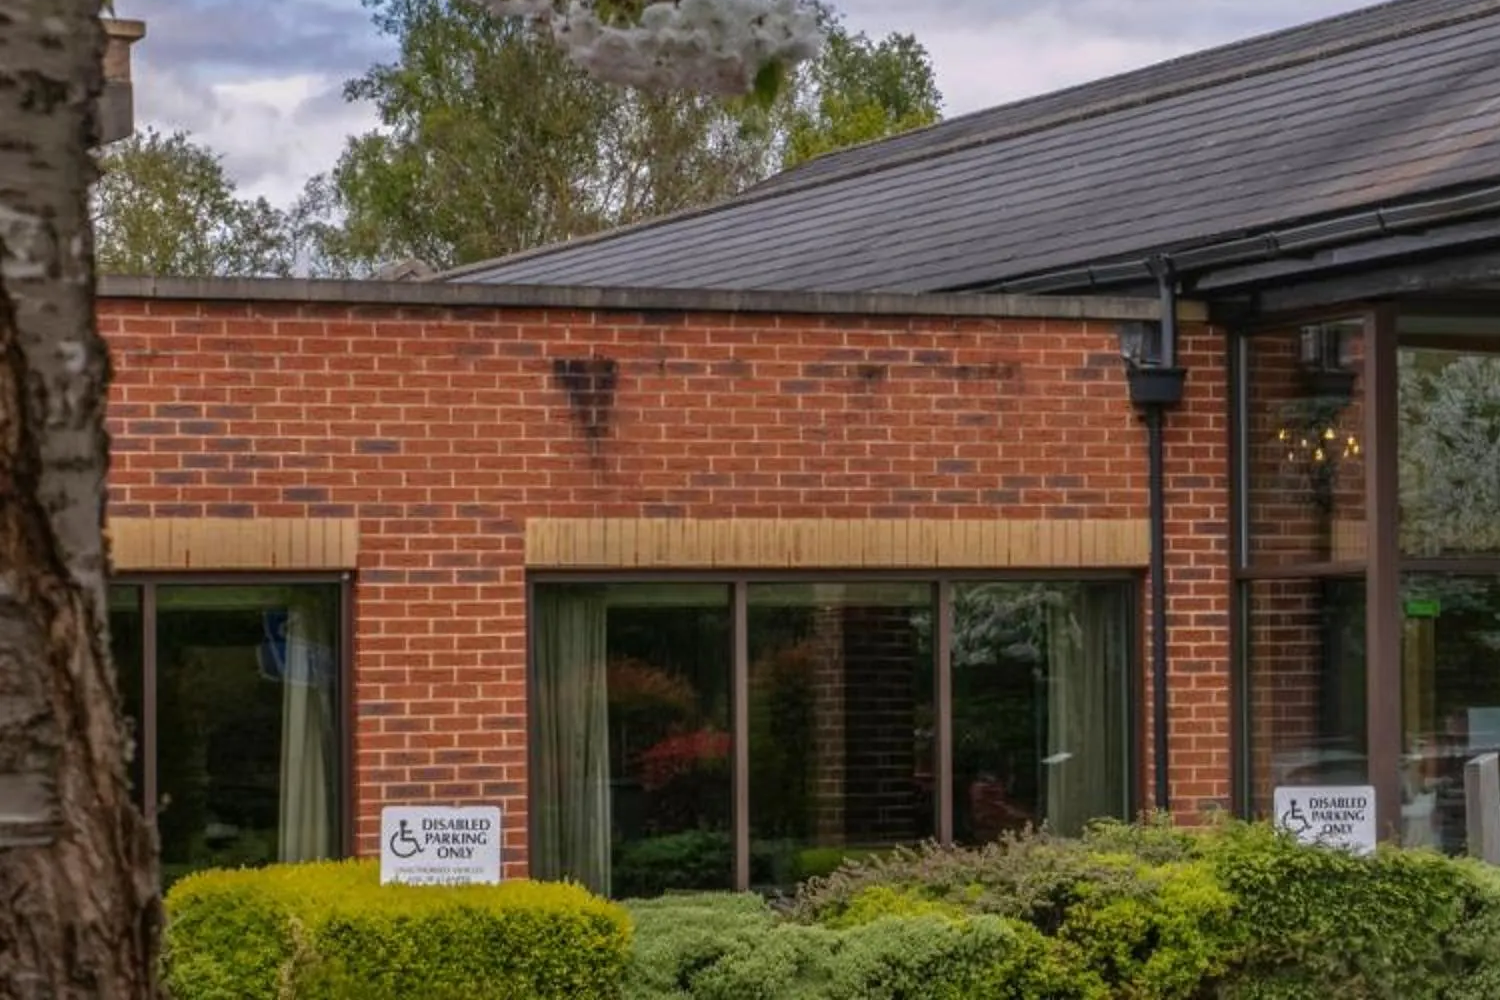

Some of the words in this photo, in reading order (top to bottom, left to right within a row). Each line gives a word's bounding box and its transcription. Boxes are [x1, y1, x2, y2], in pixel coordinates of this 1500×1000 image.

[1309, 797, 1367, 809] DISABLED
[1311, 810, 1365, 821] PARKING
[421, 818, 491, 831] DISABLED
[1322, 823, 1353, 834] ONLY
[425, 833, 487, 845] PARKING
[437, 847, 474, 859] ONLY
